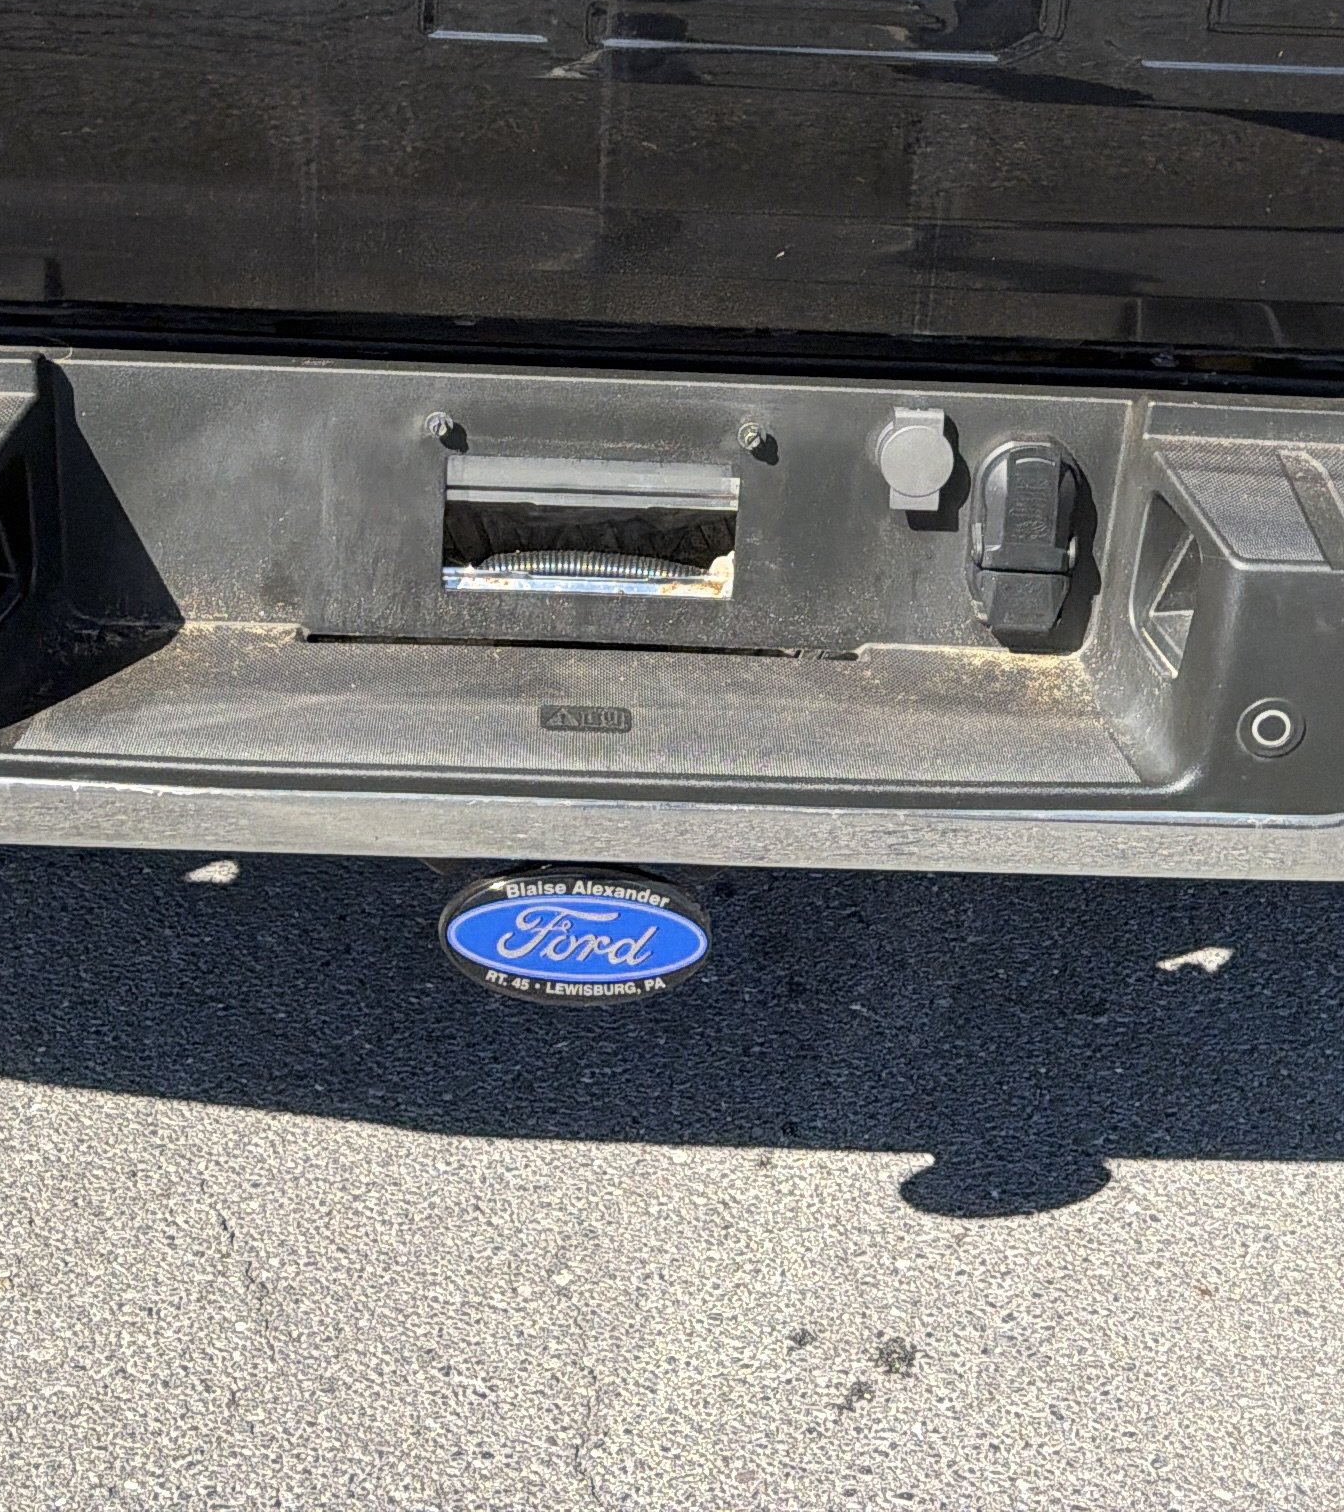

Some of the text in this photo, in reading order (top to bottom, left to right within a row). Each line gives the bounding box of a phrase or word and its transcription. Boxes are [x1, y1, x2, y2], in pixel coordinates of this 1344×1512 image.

[505, 880, 671, 909] Blaise Alexander
[496, 904, 660, 966] Ford
[484, 969, 667, 996] RT. 45 LEWISBURG, PA
